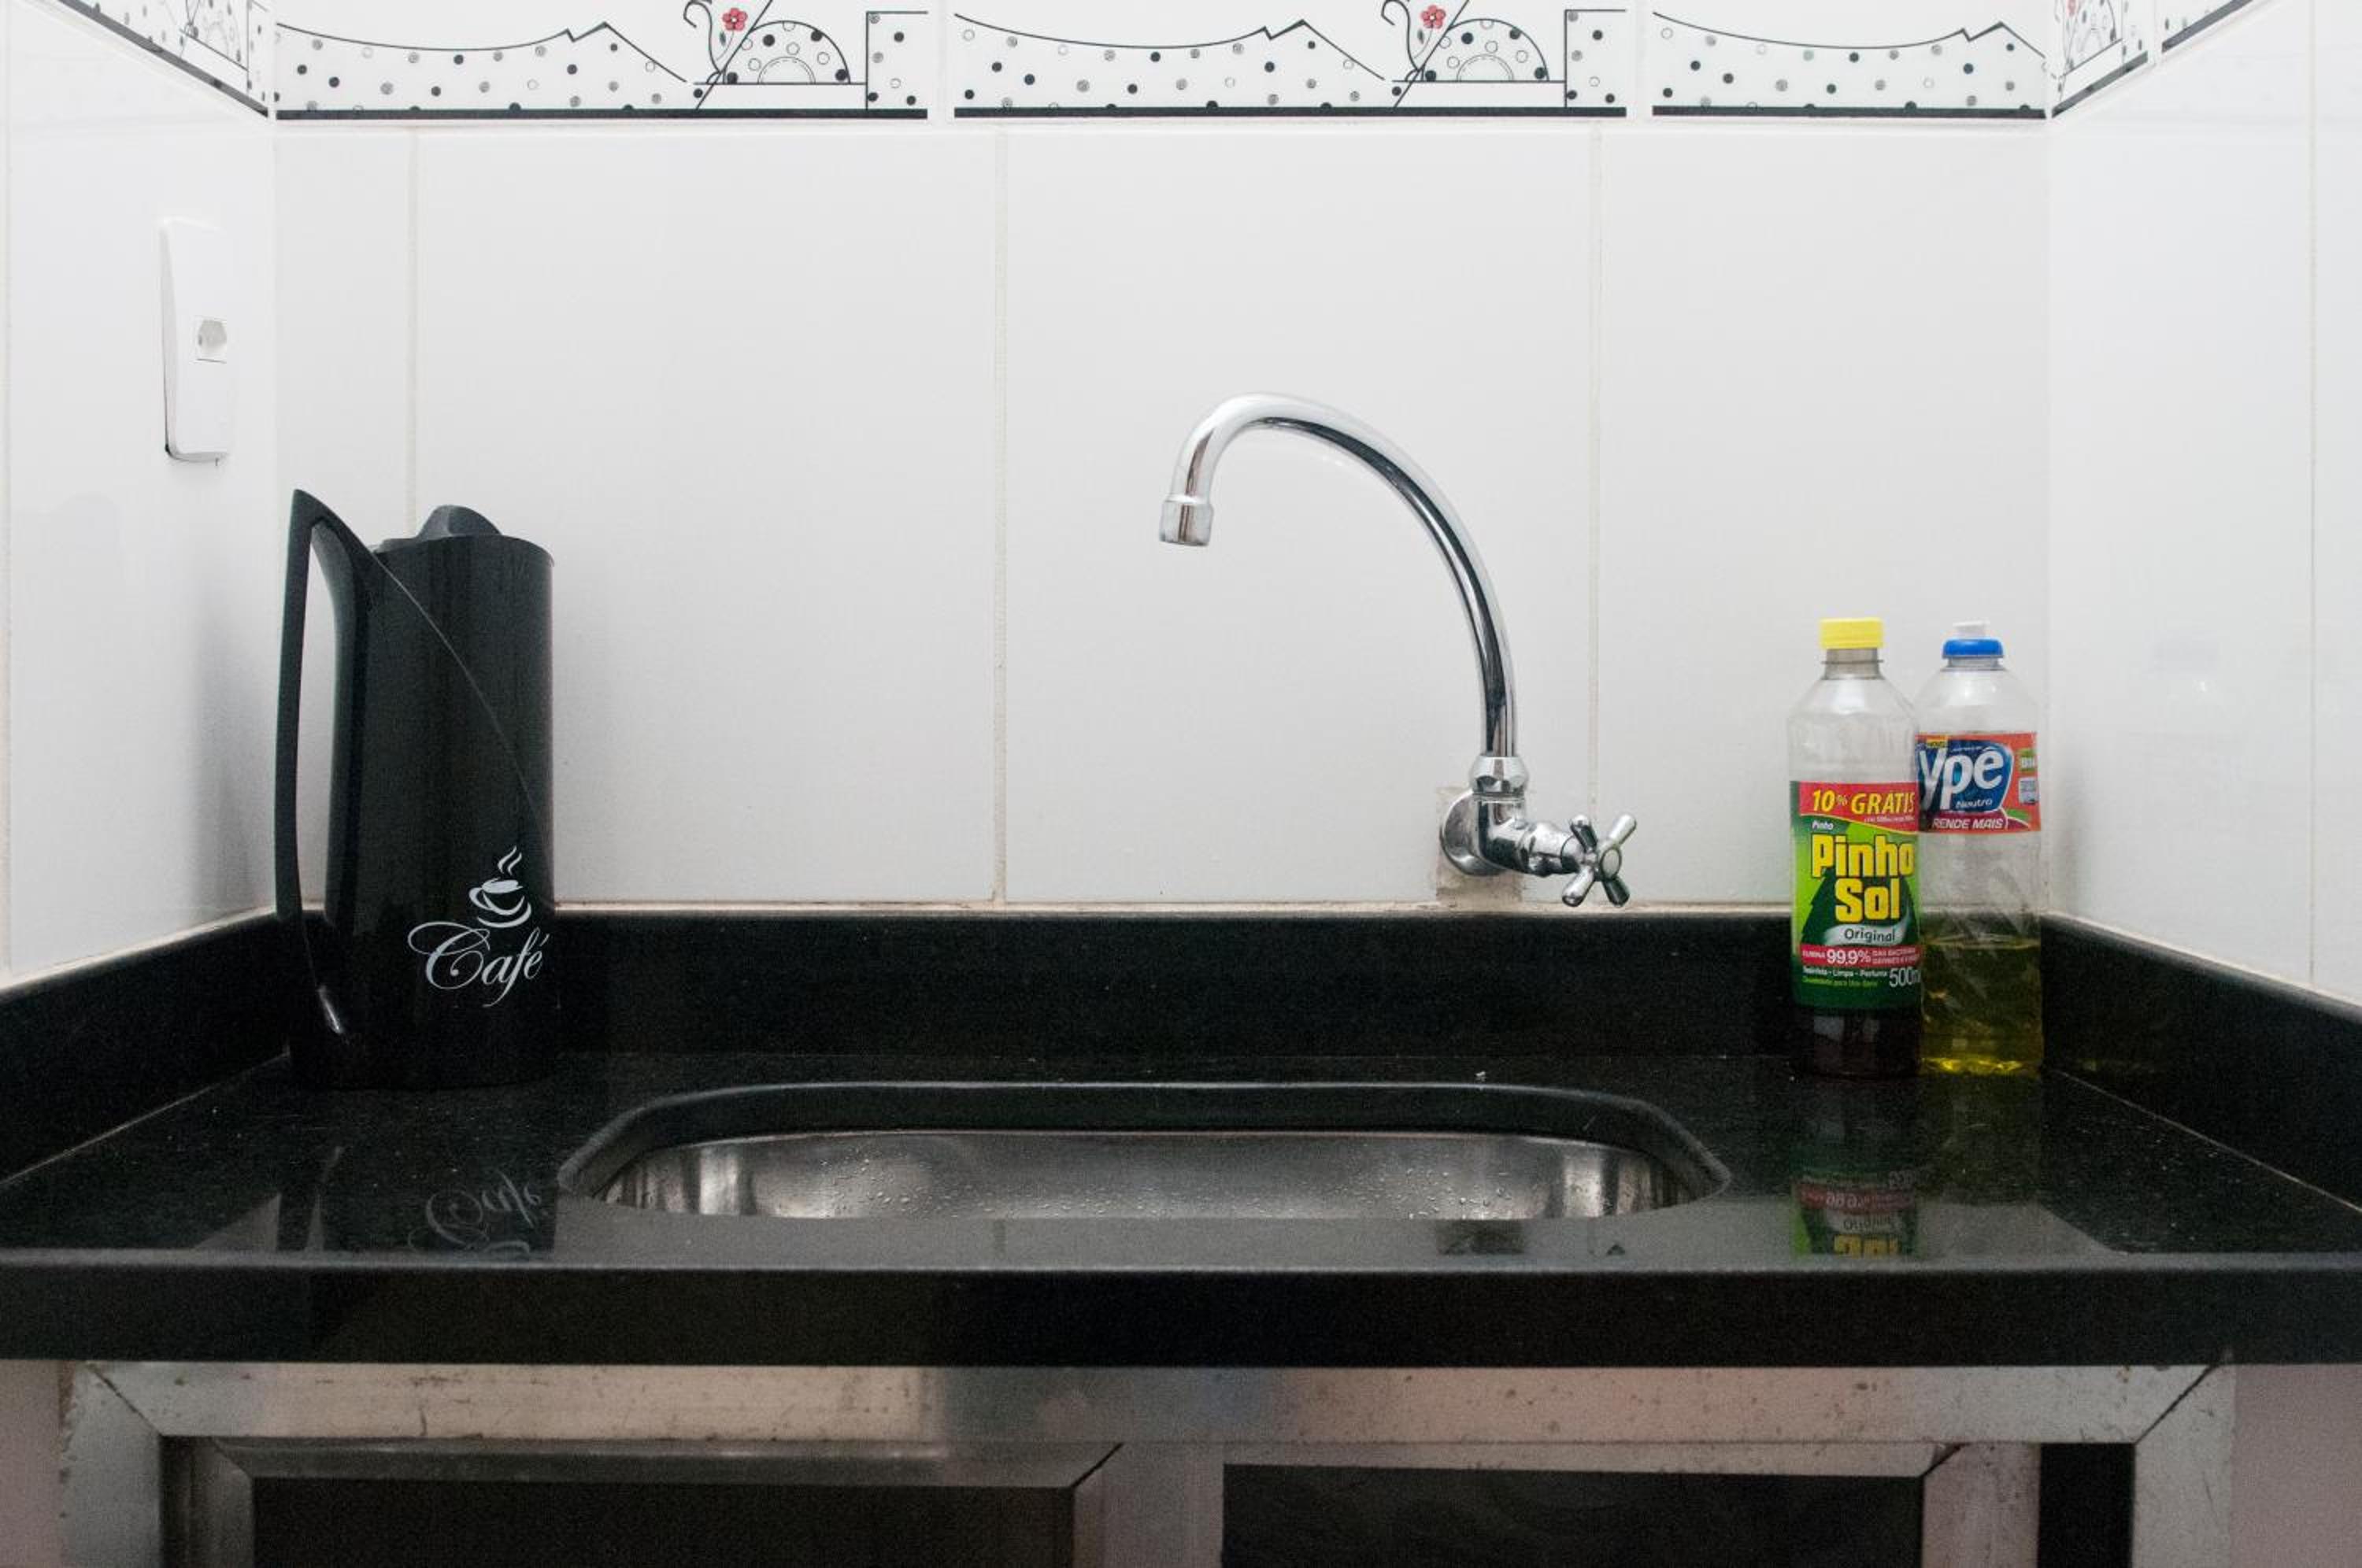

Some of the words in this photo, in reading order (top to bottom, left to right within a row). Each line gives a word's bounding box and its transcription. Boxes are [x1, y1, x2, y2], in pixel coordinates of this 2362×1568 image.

[1812, 789, 1849, 813] 10%
[1956, 797, 1993, 809] Neutro
[1931, 818, 1969, 829] RENDE
[1971, 818, 2004, 829] MAIS
[1812, 834, 1915, 878] Pinho
[1834, 876, 1900, 924] Sol
[1844, 928, 1895, 944] Original
[407, 920, 550, 1008] Café
